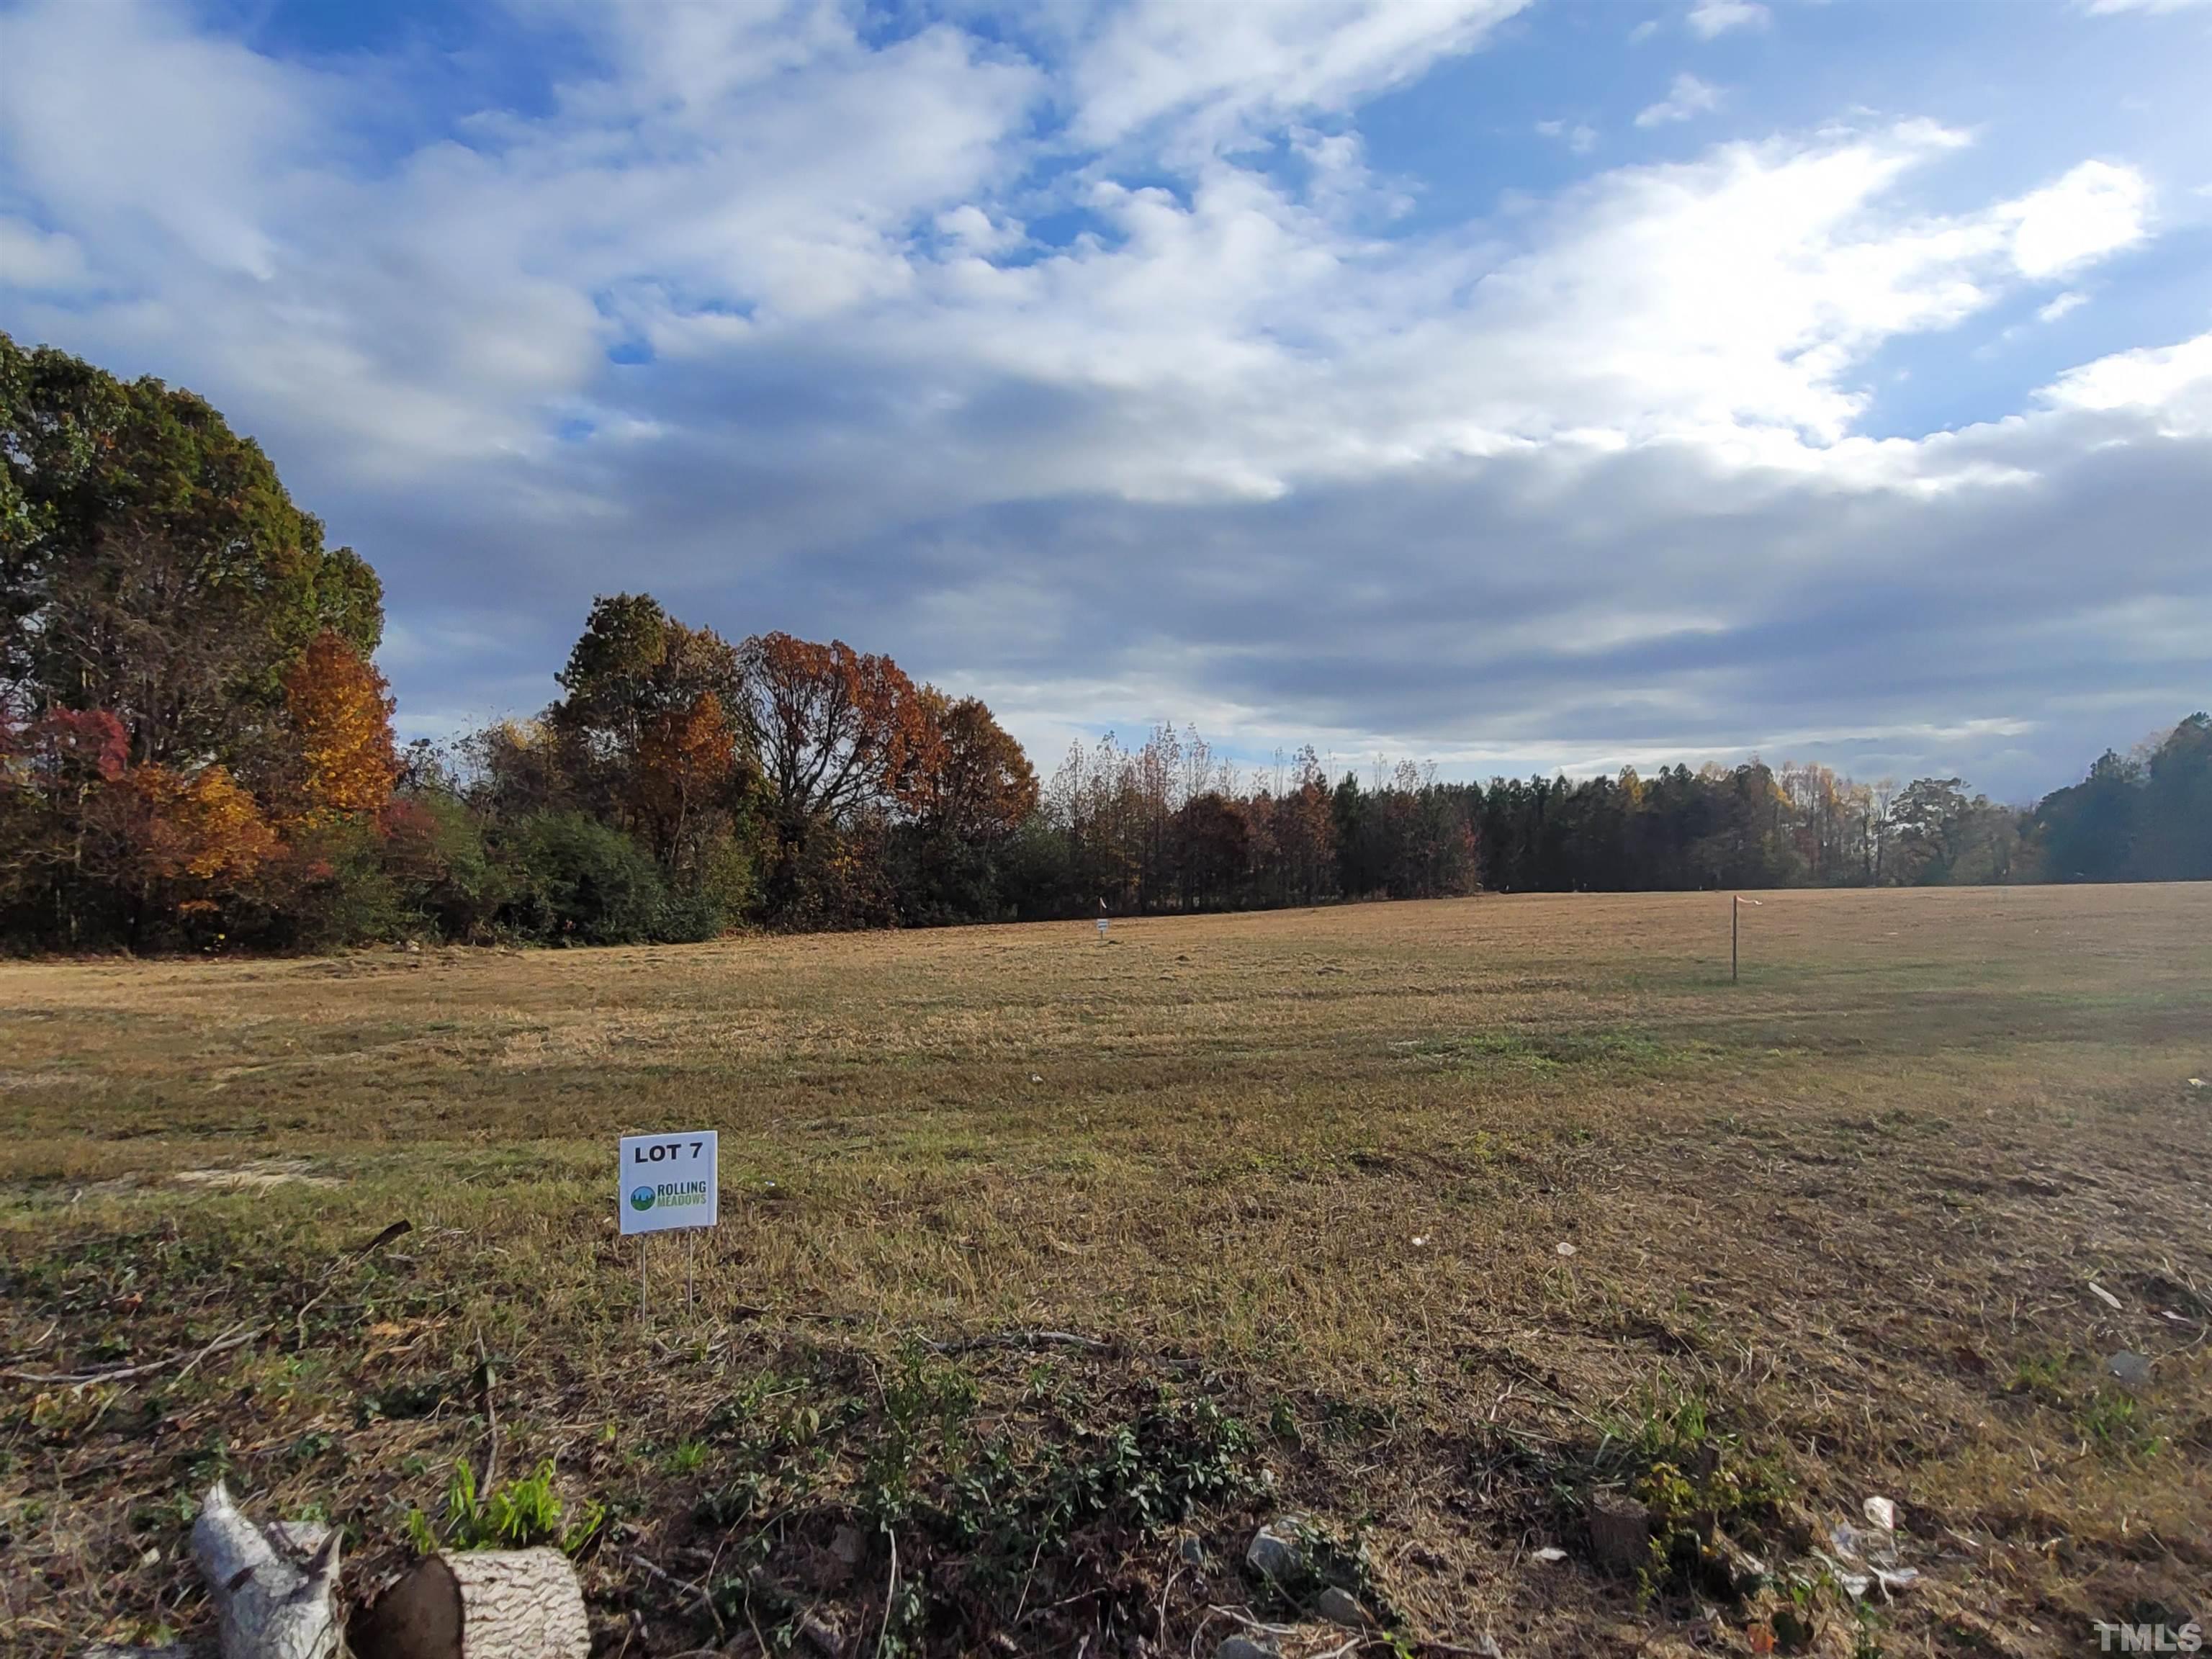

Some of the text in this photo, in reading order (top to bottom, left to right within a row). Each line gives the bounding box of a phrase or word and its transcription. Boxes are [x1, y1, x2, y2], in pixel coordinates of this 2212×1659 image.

[635, 1142, 703, 1164] LOT 7
[657, 1181, 706, 1196] ROLLING
[657, 1194, 706, 1208] MEADOWS
